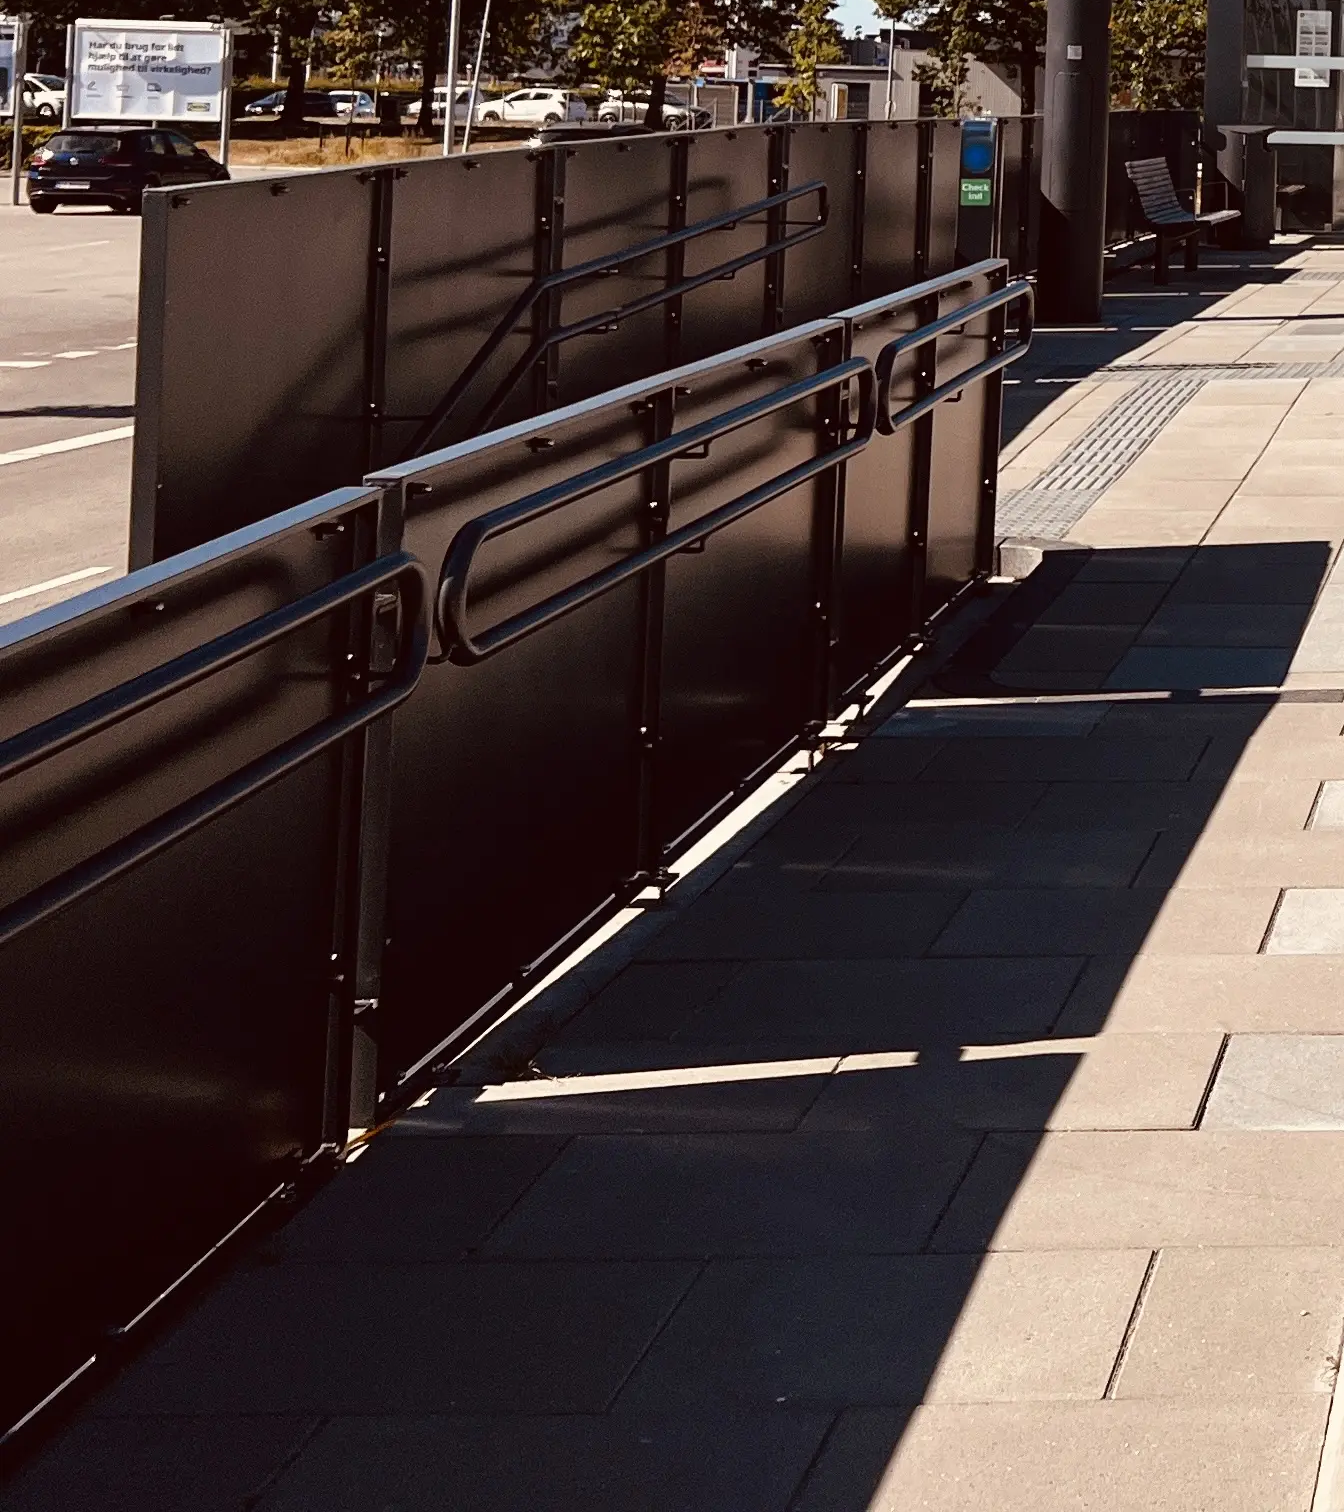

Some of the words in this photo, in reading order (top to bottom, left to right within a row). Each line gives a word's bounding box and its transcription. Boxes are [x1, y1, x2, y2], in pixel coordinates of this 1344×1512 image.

[125, 43, 148, 53] brug
[151, 43, 165, 51] for
[962, 184, 989, 192] Check
